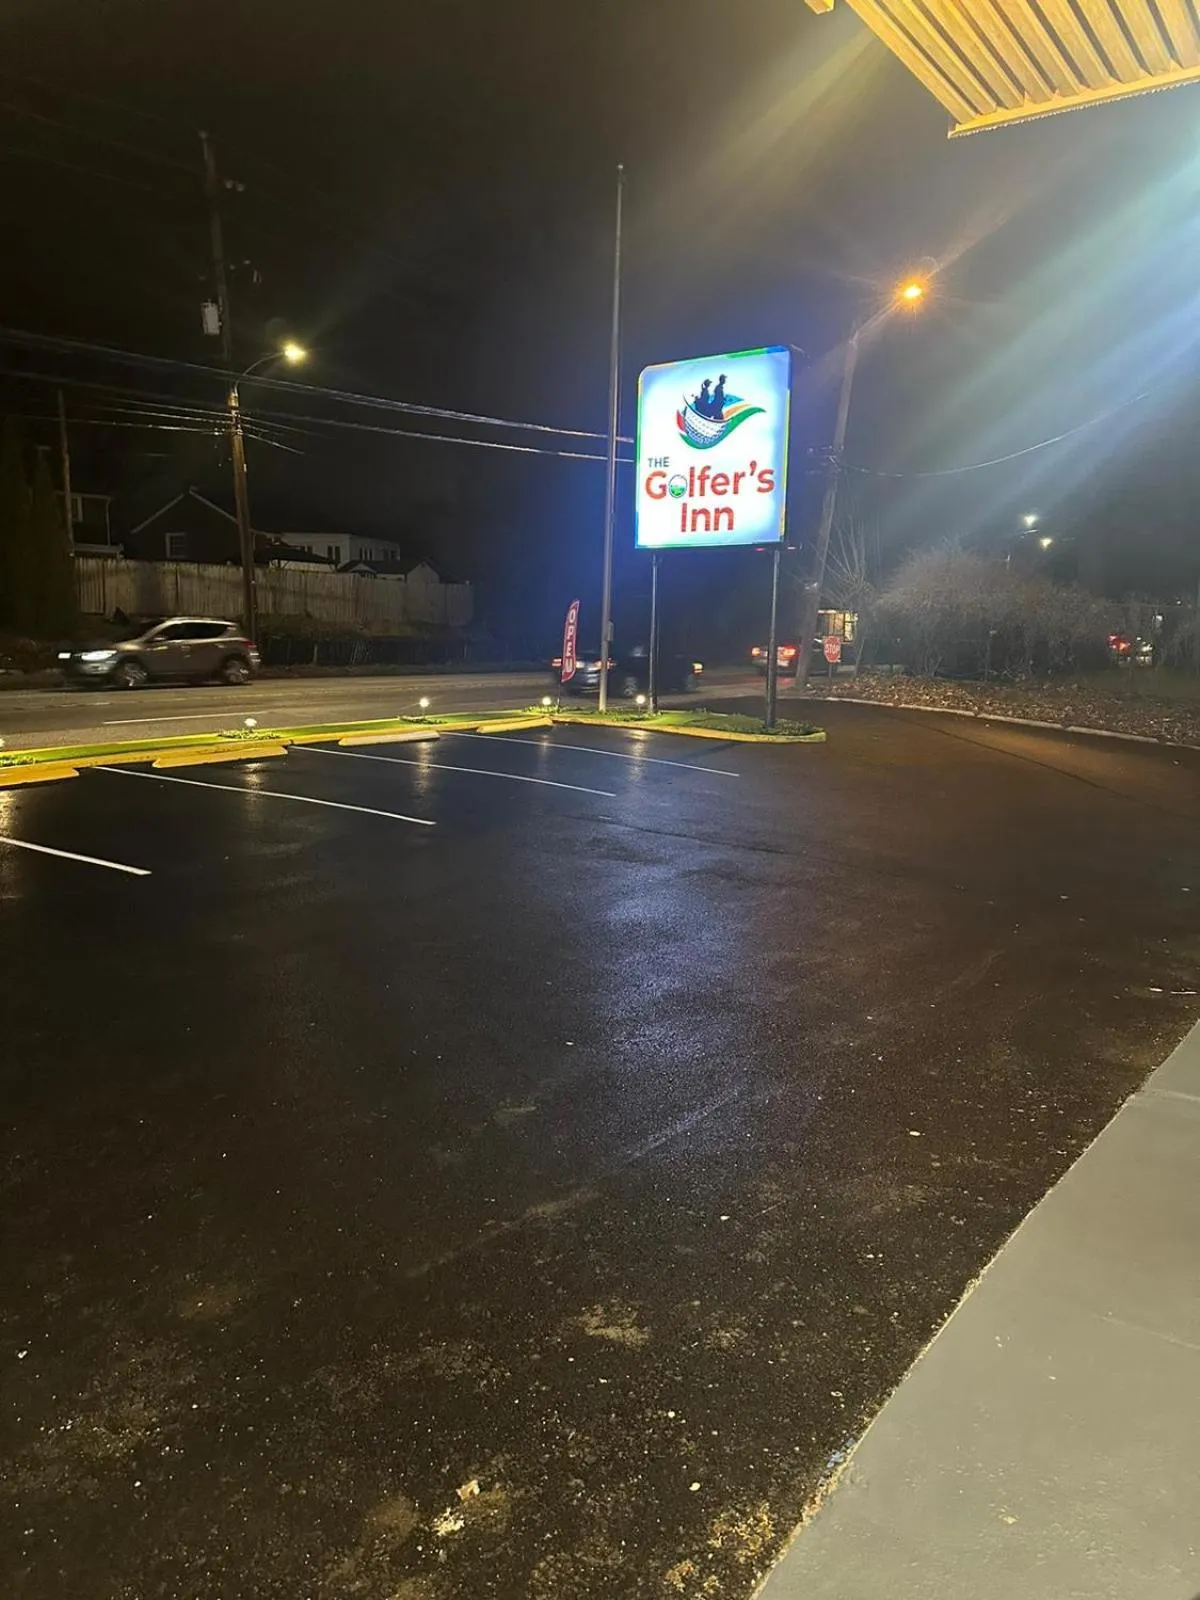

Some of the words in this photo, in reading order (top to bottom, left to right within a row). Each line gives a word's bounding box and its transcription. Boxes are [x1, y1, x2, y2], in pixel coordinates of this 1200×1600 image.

[647, 456, 670, 468] THE
[645, 460, 775, 500] Golfer's
[681, 502, 734, 532] Inn
[565, 608, 577, 673] OPEN
[824, 643, 841, 655] STOP
